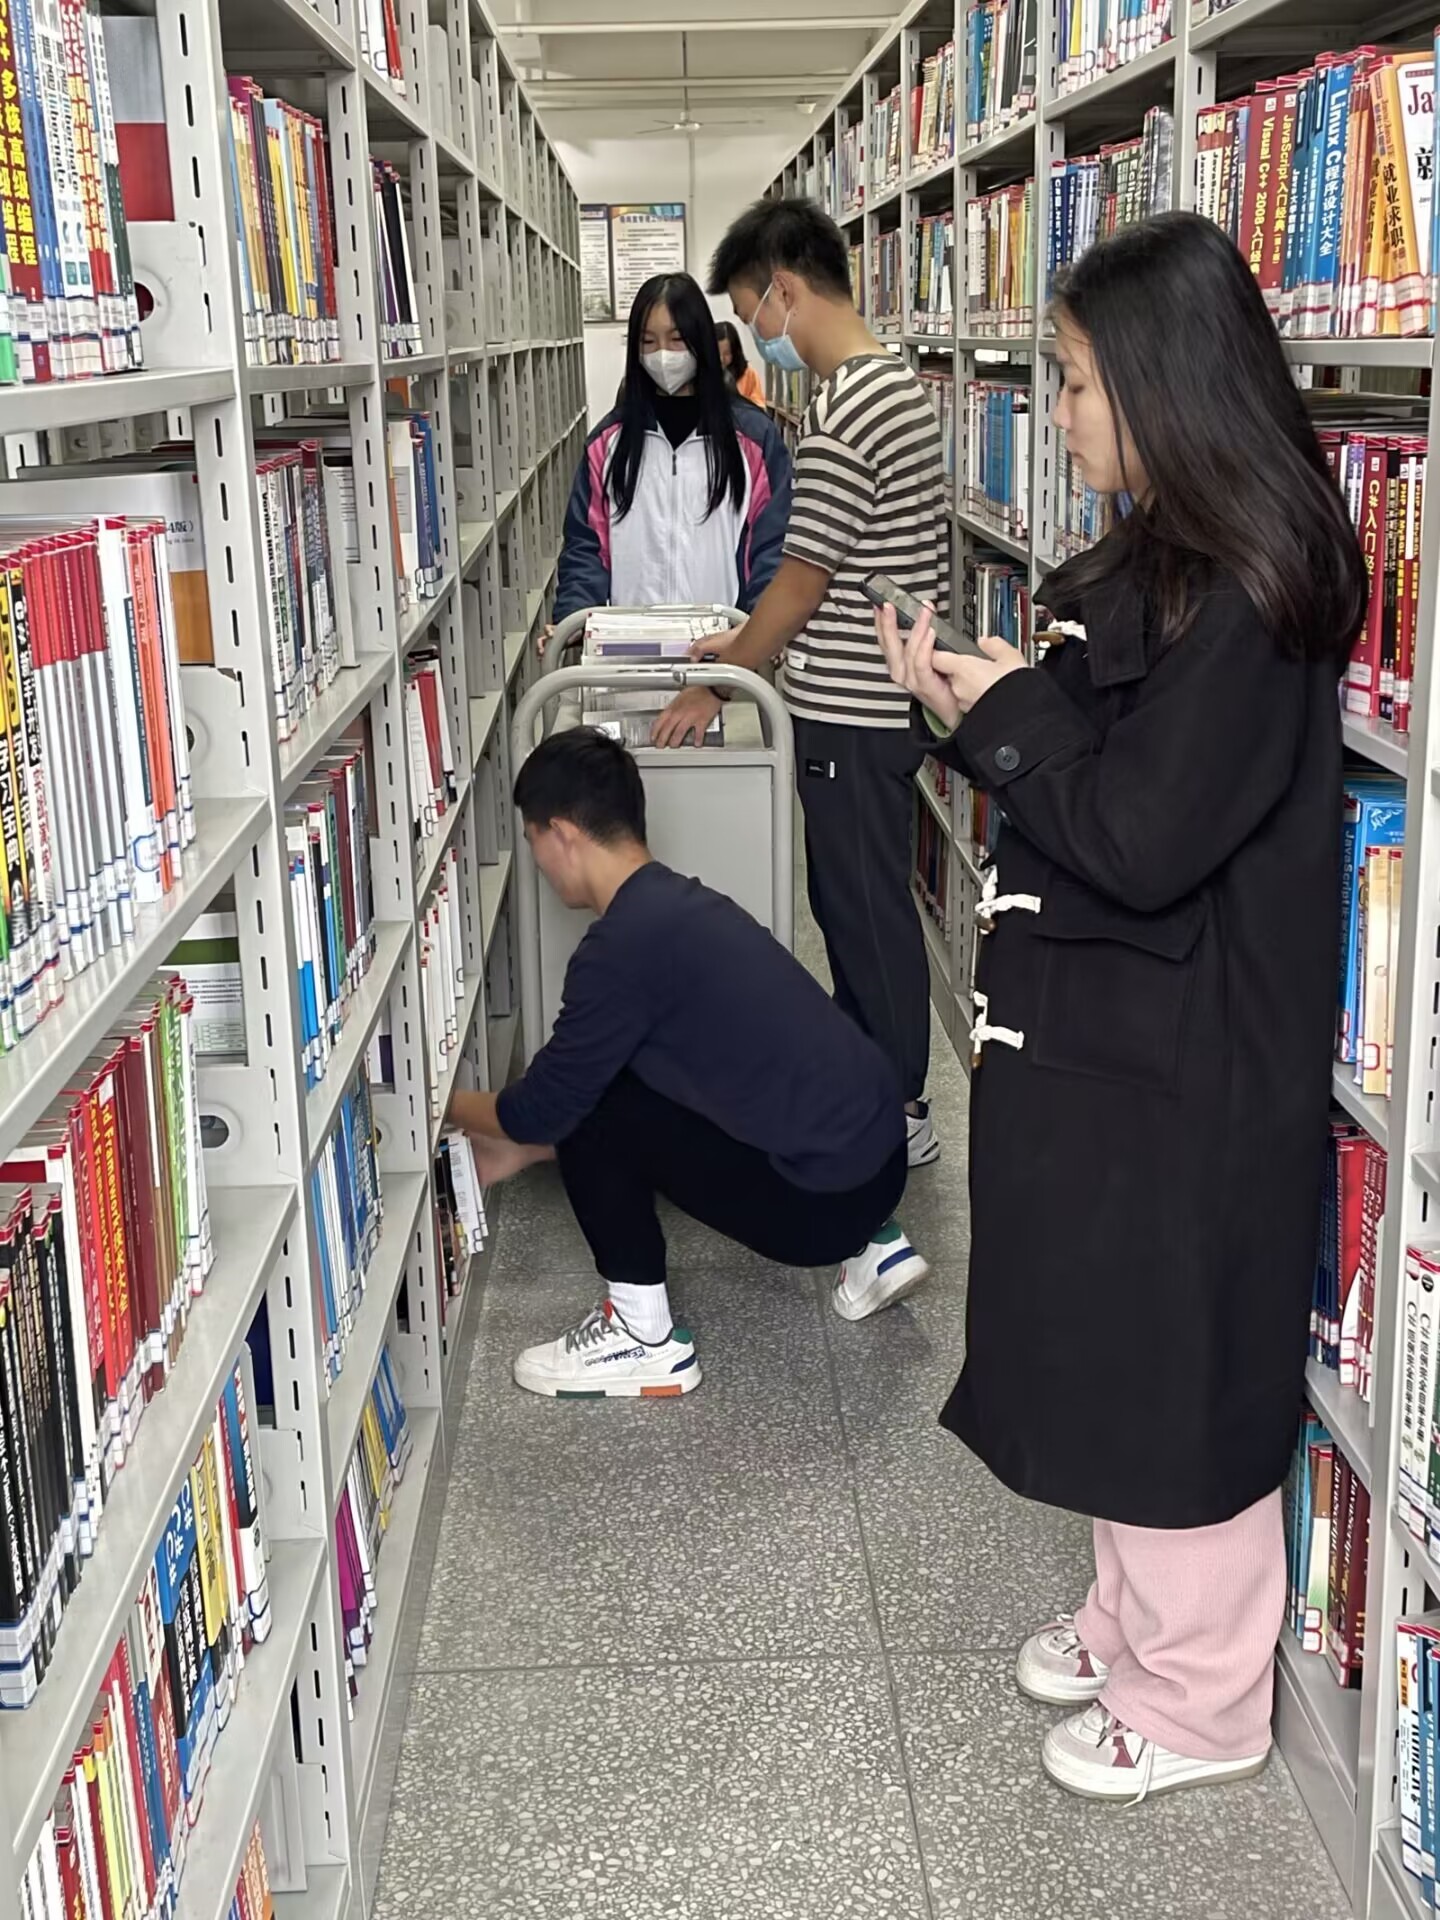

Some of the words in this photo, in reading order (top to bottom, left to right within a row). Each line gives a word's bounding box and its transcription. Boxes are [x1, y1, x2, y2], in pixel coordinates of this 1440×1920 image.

[1326, 89, 1347, 148] Linux
[1407, 84, 1435, 115] Ja
[47, 93, 66, 189] Hibernate
[61, 97, 79, 191] Hibernate
[1260, 117, 1275, 160] Visual
[2, 68, 38, 265] 多核高级编程
[1259, 162, 1271, 189] C++
[1382, 162, 1405, 247] 就业求职
[1399, 483, 1407, 506] PHP
[181, 1478, 194, 1531] C#
[165, 1531, 178, 1588] C#
[171, 1507, 185, 1560] C#
